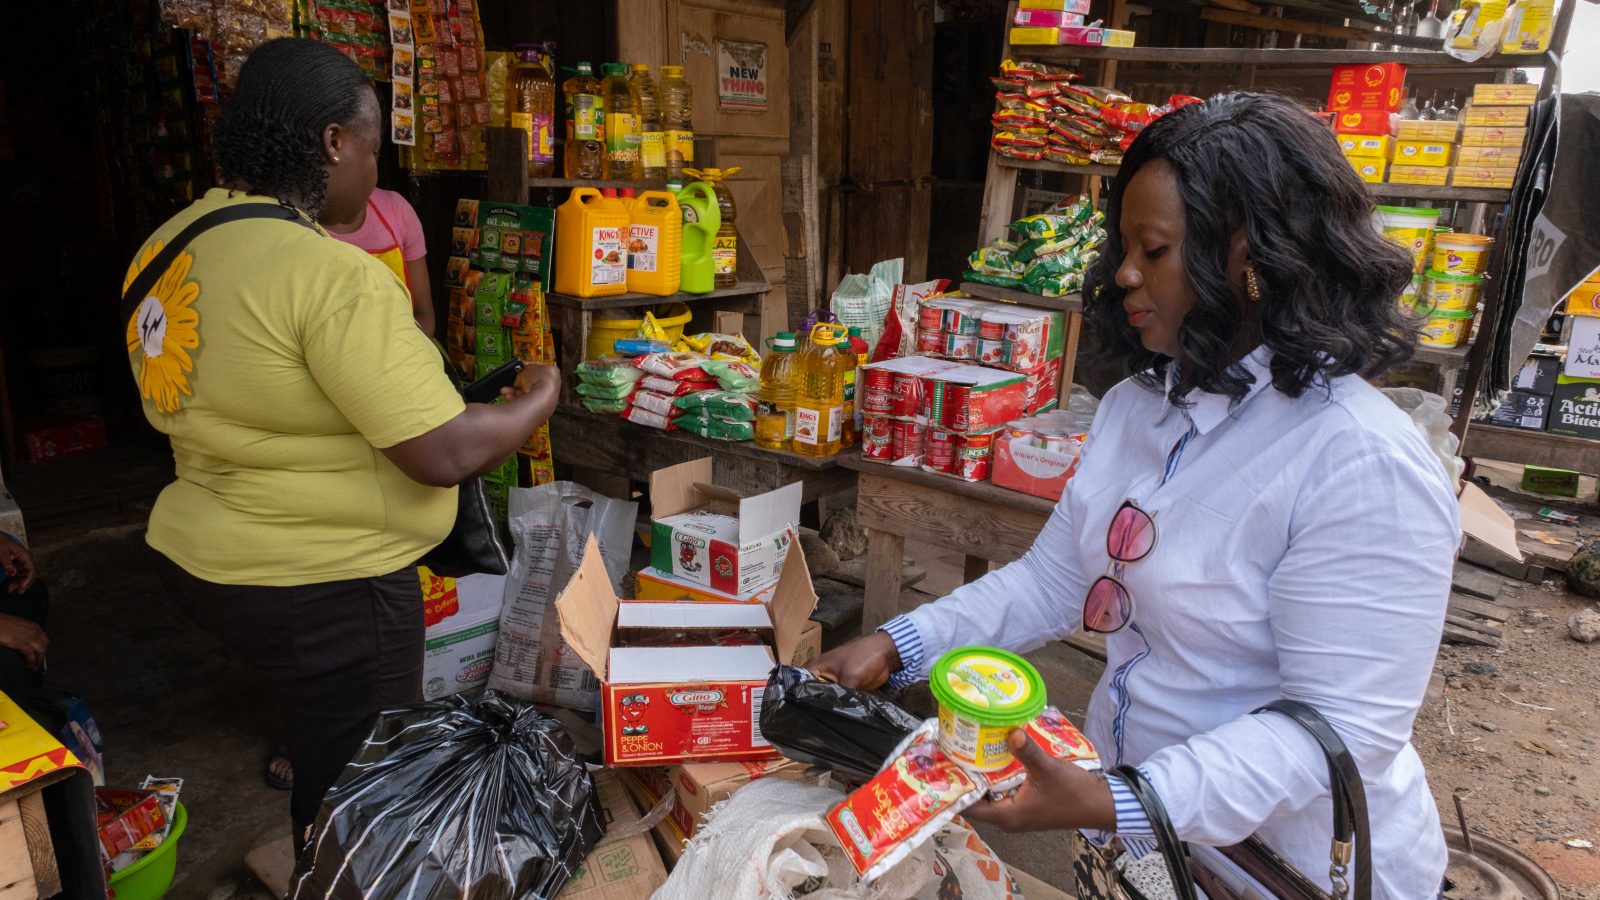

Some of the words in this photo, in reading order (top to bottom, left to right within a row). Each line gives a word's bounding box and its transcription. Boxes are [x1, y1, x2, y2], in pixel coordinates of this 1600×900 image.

[729, 66, 759, 80] NEW
[721, 77, 765, 95] THING
[1040, 456, 1067, 468] Original
[682, 534, 698, 544] Gino
[682, 693, 710, 702] Gino
[621, 735, 649, 745] PEPPE
[621, 744, 629, 753] &
[629, 742, 663, 752] ONION
